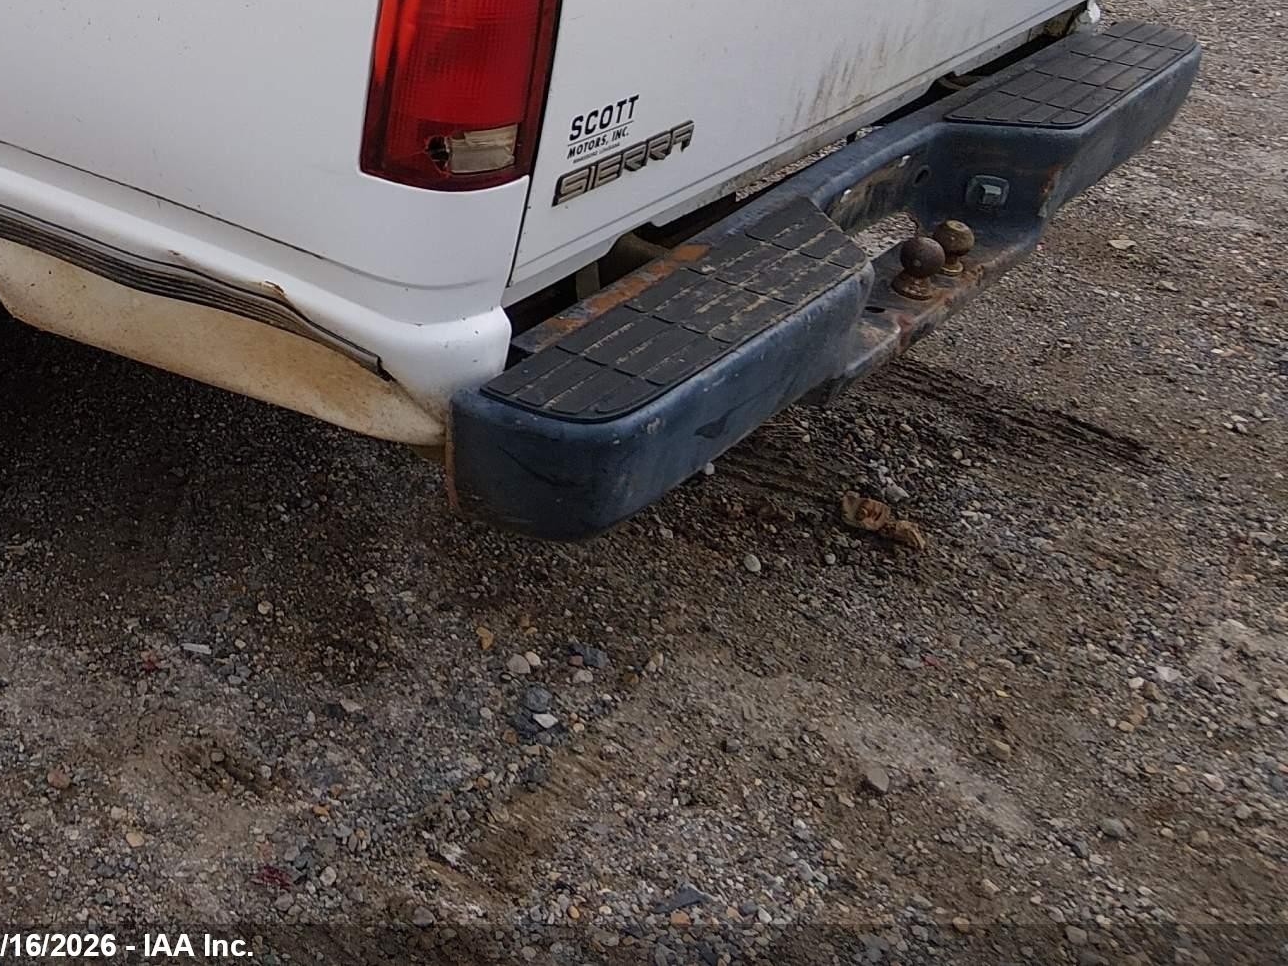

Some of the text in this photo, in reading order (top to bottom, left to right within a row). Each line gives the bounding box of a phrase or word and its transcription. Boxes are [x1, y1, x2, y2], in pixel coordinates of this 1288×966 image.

[569, 94, 640, 141] SCOTT
[611, 126, 630, 142] INC.
[552, 120, 695, 207] SIERRA
